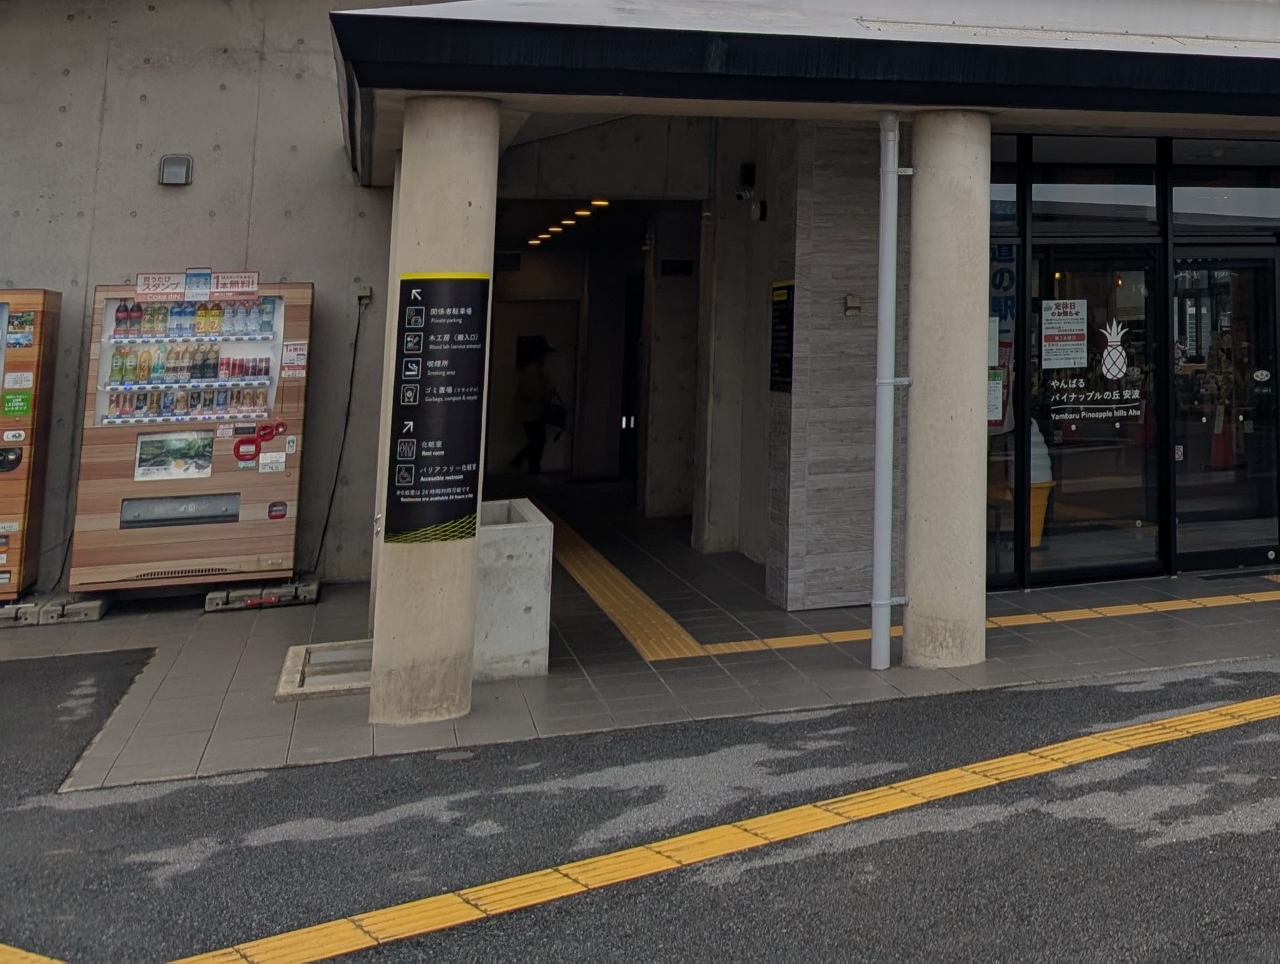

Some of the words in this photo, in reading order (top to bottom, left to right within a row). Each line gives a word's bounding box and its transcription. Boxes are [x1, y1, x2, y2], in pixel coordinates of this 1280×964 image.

[142, 282, 180, 291] スタンプ
[1054, 302, 1076, 311] 定休日
[1051, 379, 1085, 388] やんばる
[1051, 391, 1120, 402] パイナップルの丘
[1122, 389, 1140, 399] 安波
[1051, 412, 1080, 420] Yambaru
[1081, 410, 1113, 419] Pineapple
[1114, 409, 1127, 417] hills
[1128, 408, 1141, 416] Aha
